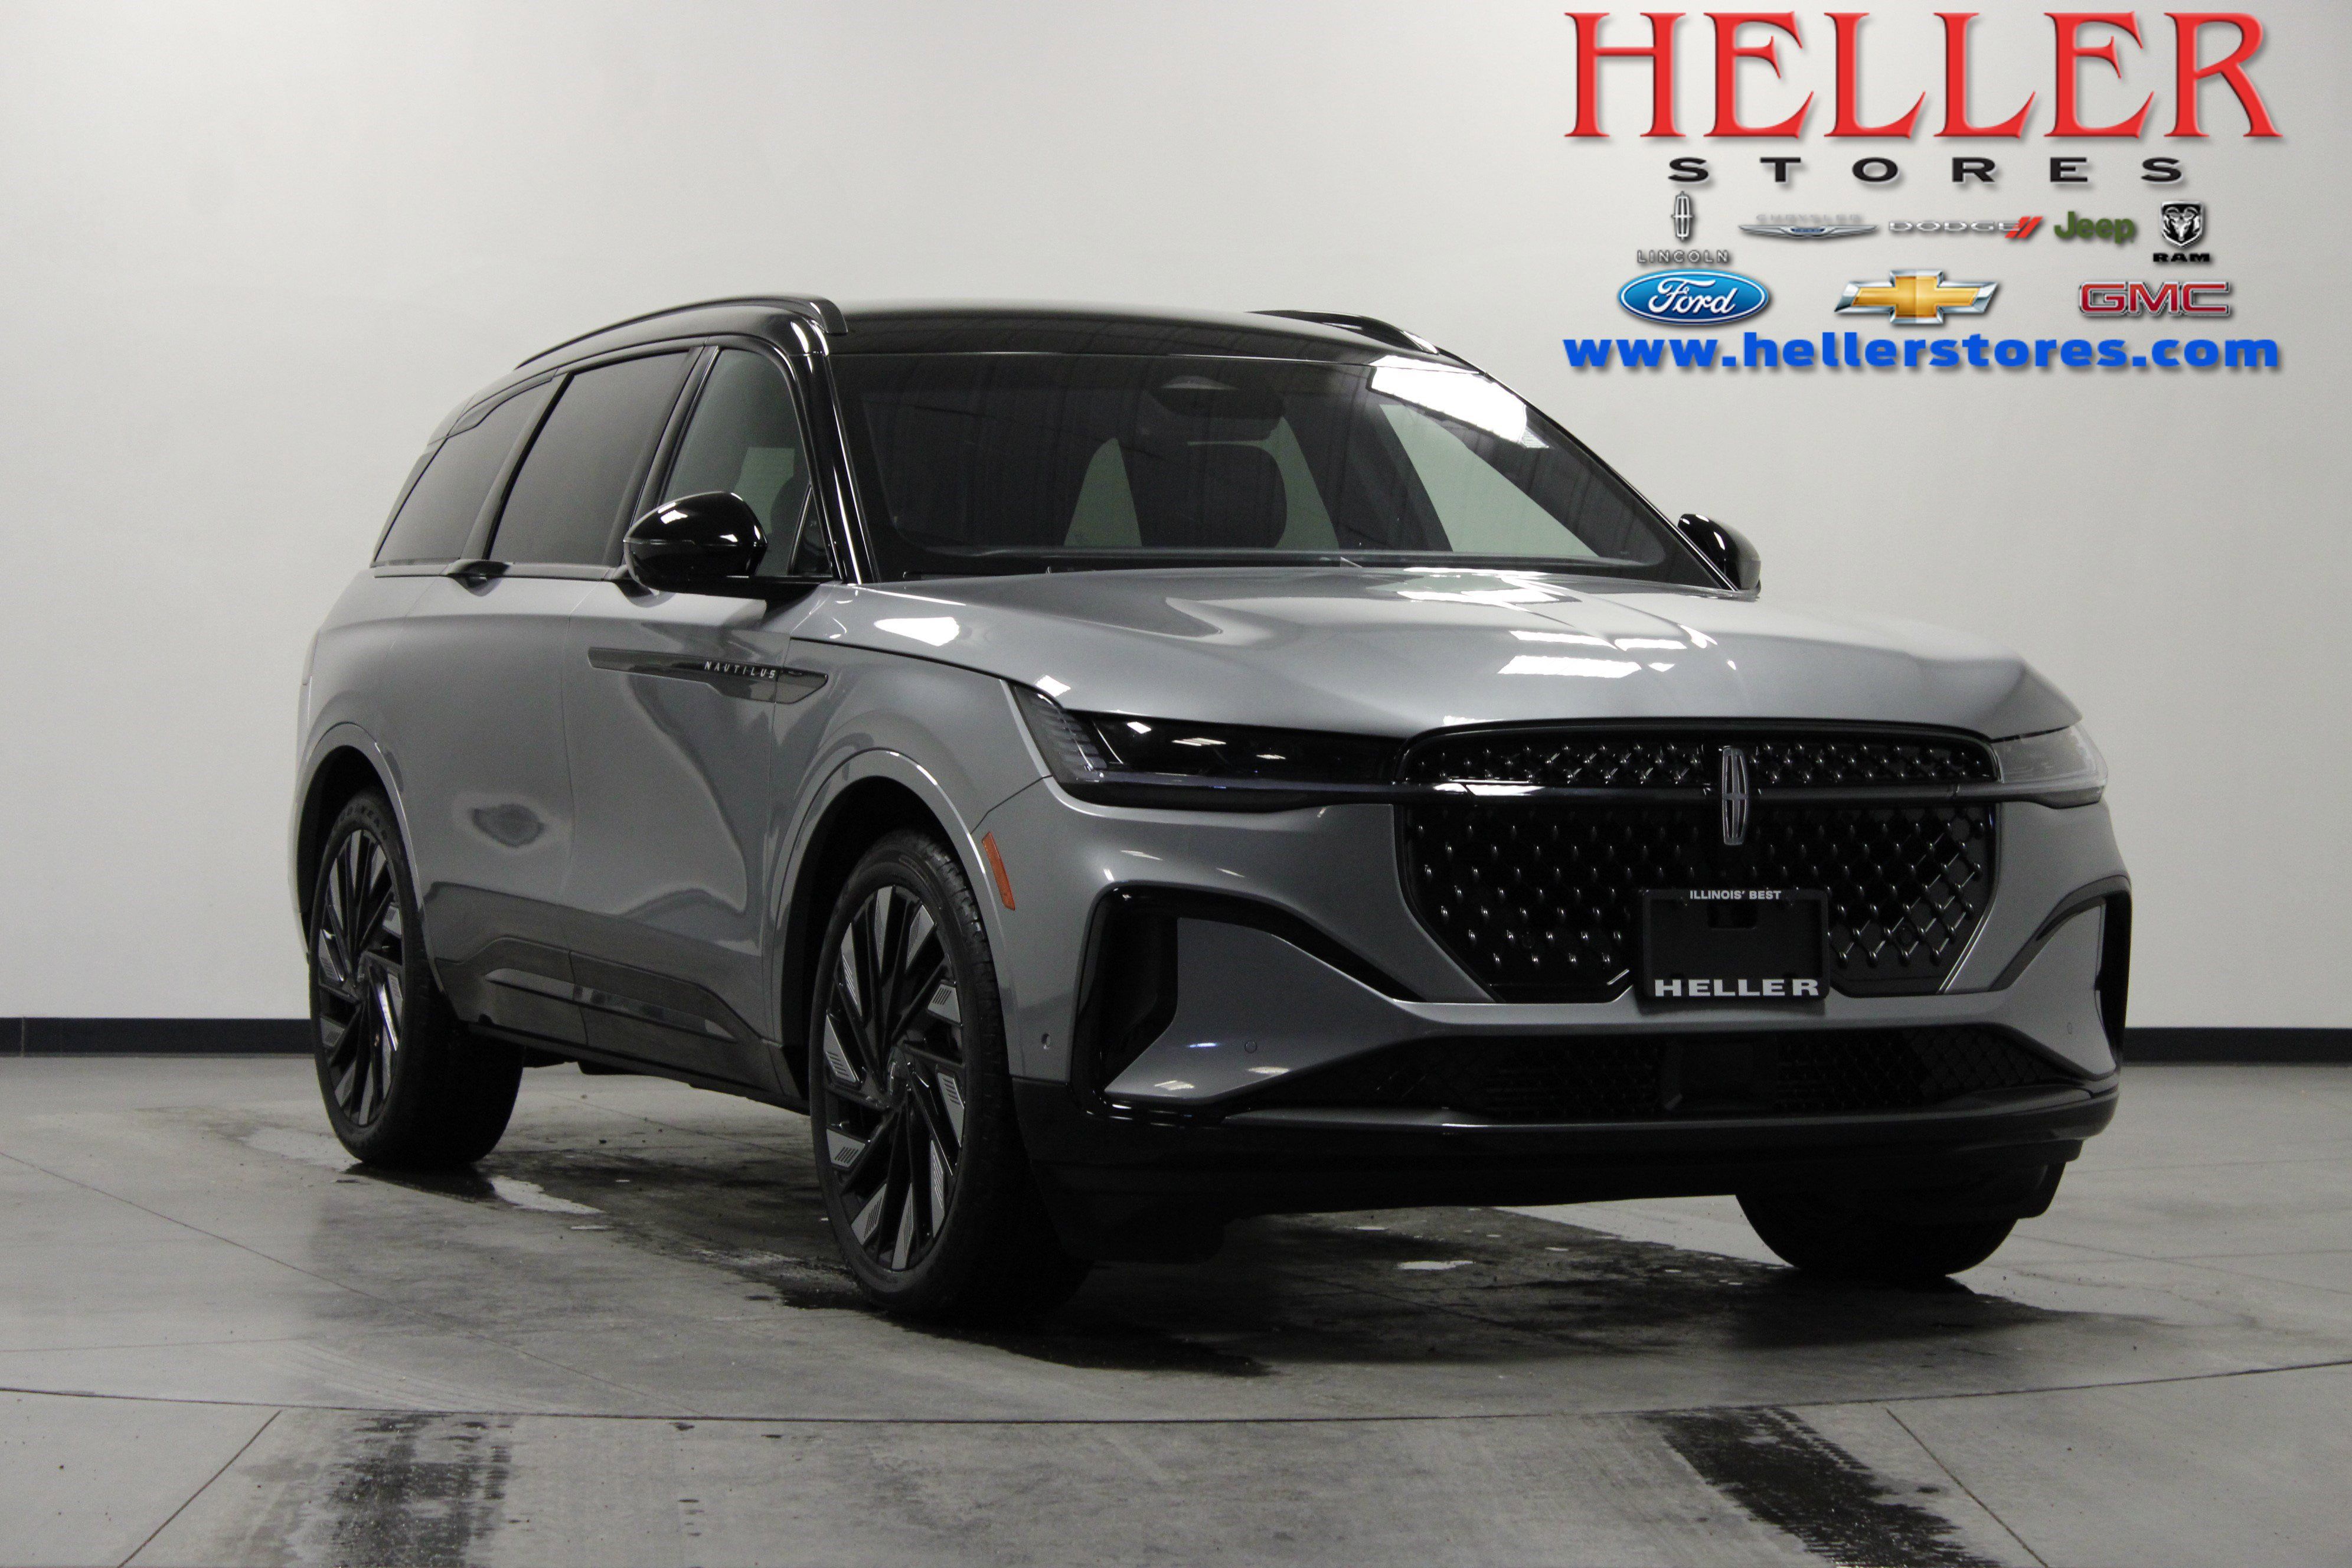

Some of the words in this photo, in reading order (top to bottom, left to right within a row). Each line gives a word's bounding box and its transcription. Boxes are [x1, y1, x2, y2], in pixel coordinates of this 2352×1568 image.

[704, 661, 776, 678] NAUTILUS
[1749, 890, 1782, 900] BEST
[1655, 979, 1819, 997] HELLER
